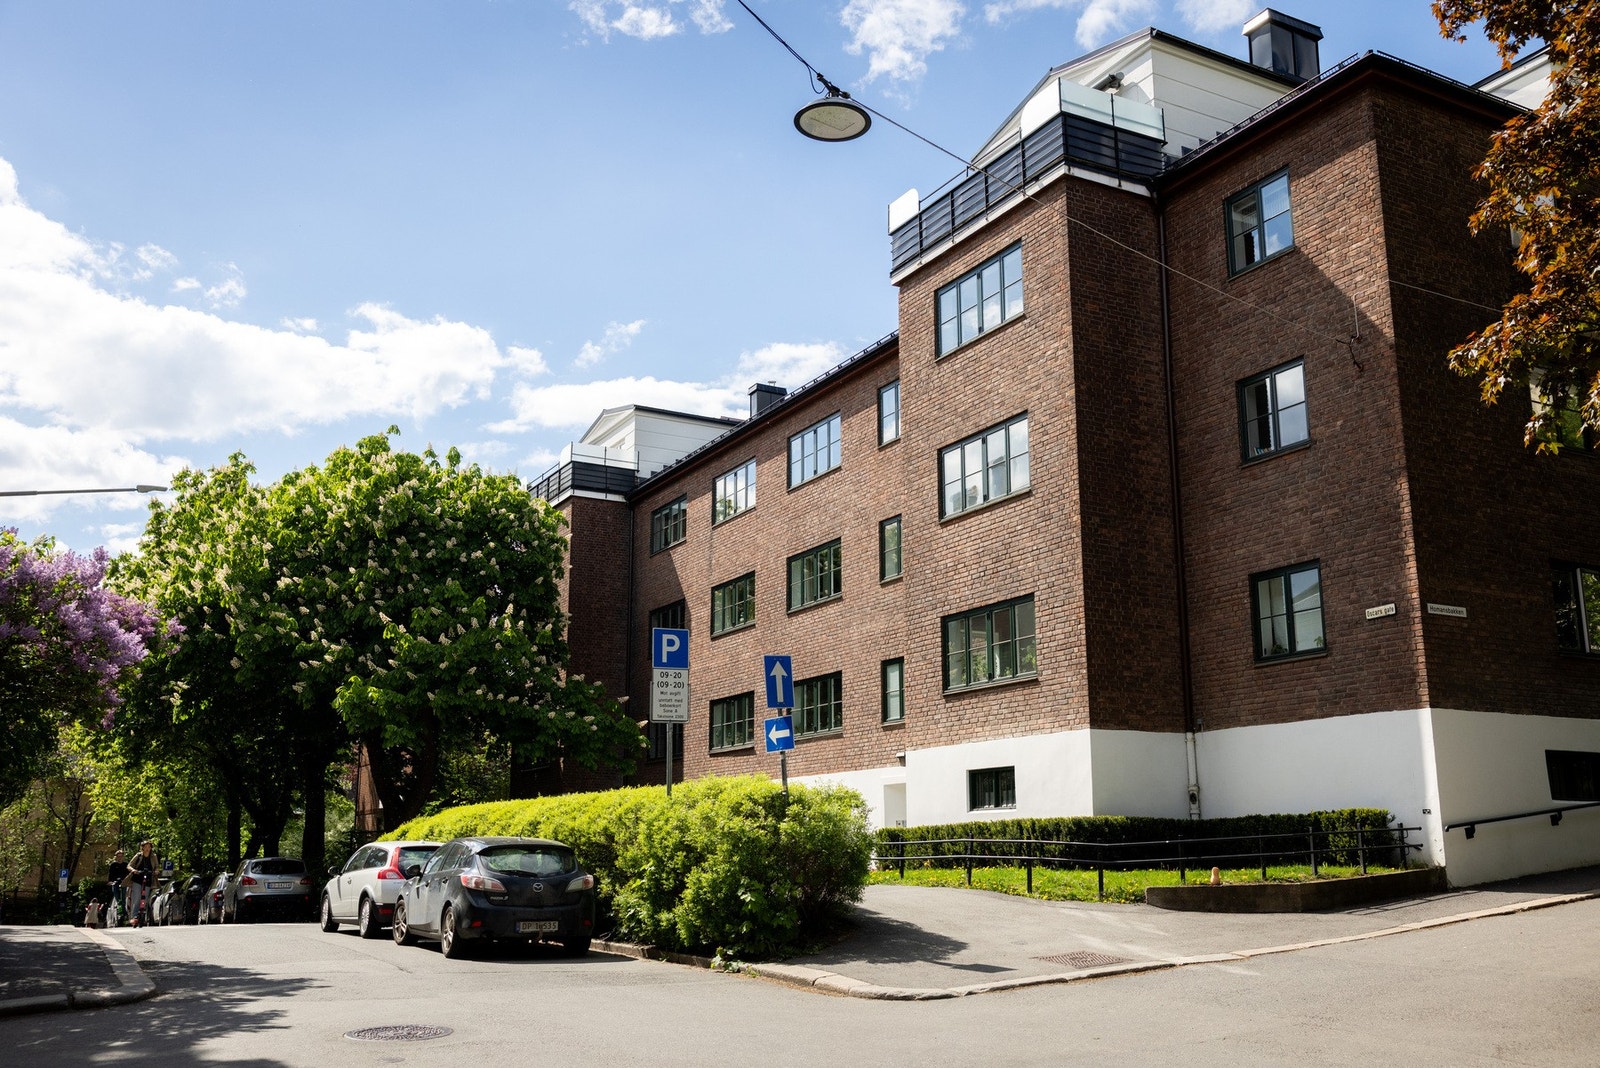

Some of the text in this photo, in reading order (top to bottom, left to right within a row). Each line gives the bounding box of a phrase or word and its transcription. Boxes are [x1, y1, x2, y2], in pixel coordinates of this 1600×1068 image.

[1366, 605, 1395, 618] Oscars gate
[1429, 604, 1465, 616] Homansbakken
[661, 633, 681, 663] P
[521, 922, 532, 930] DP
